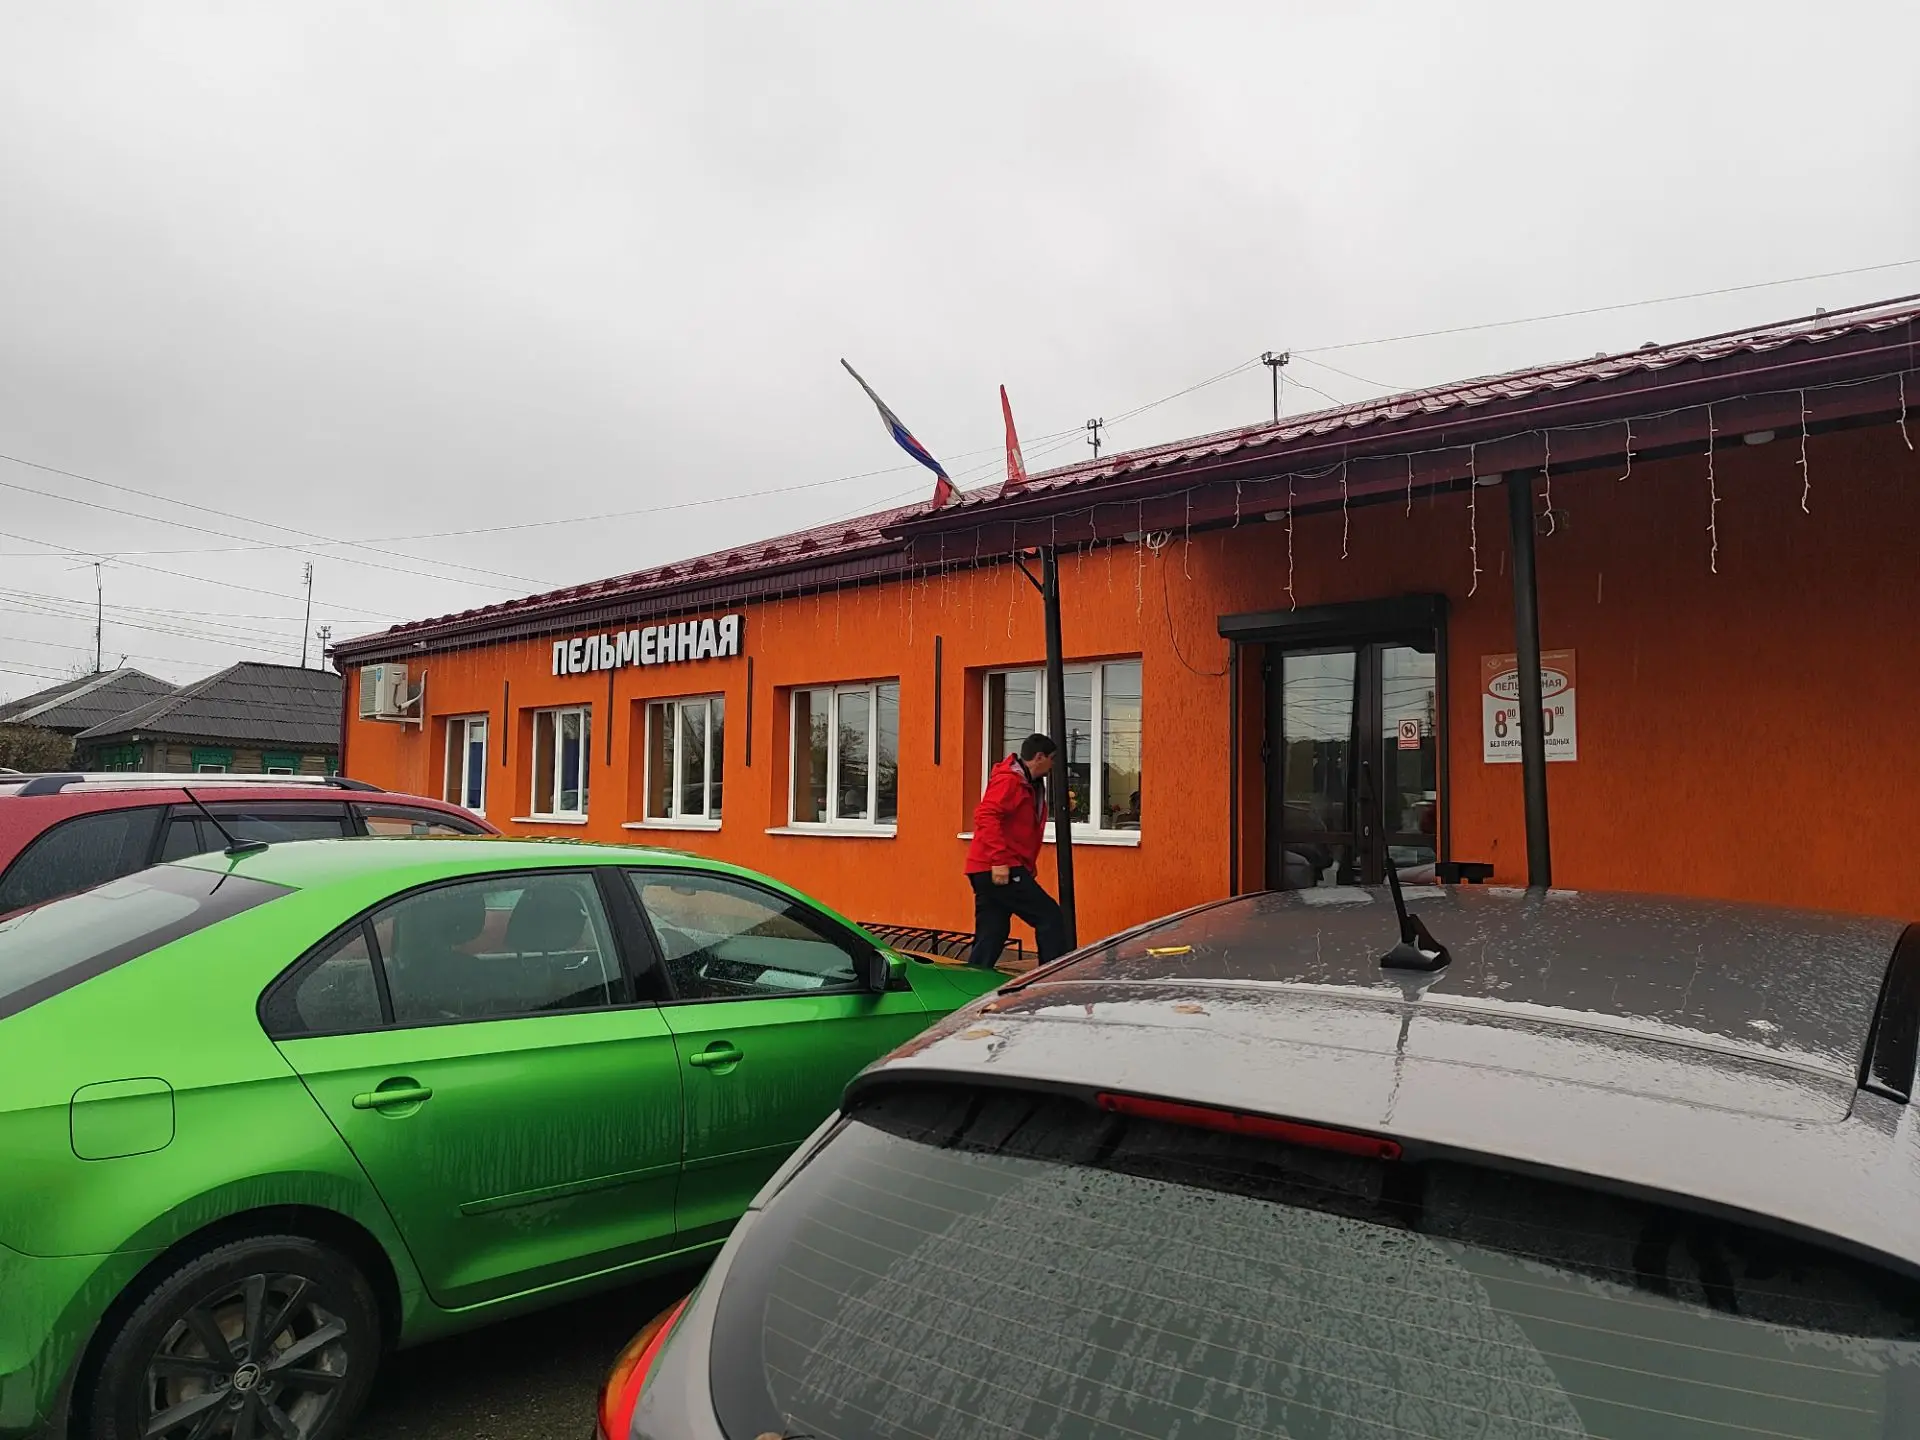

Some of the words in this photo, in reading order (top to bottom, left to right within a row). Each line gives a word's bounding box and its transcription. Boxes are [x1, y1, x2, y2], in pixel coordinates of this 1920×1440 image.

[552, 614, 739, 676] ПЕЛЬМЕННАЯ
[1495, 678, 1562, 691] ПЕЛЬНАЯ
[1490, 740, 1500, 748] БЕЗ
